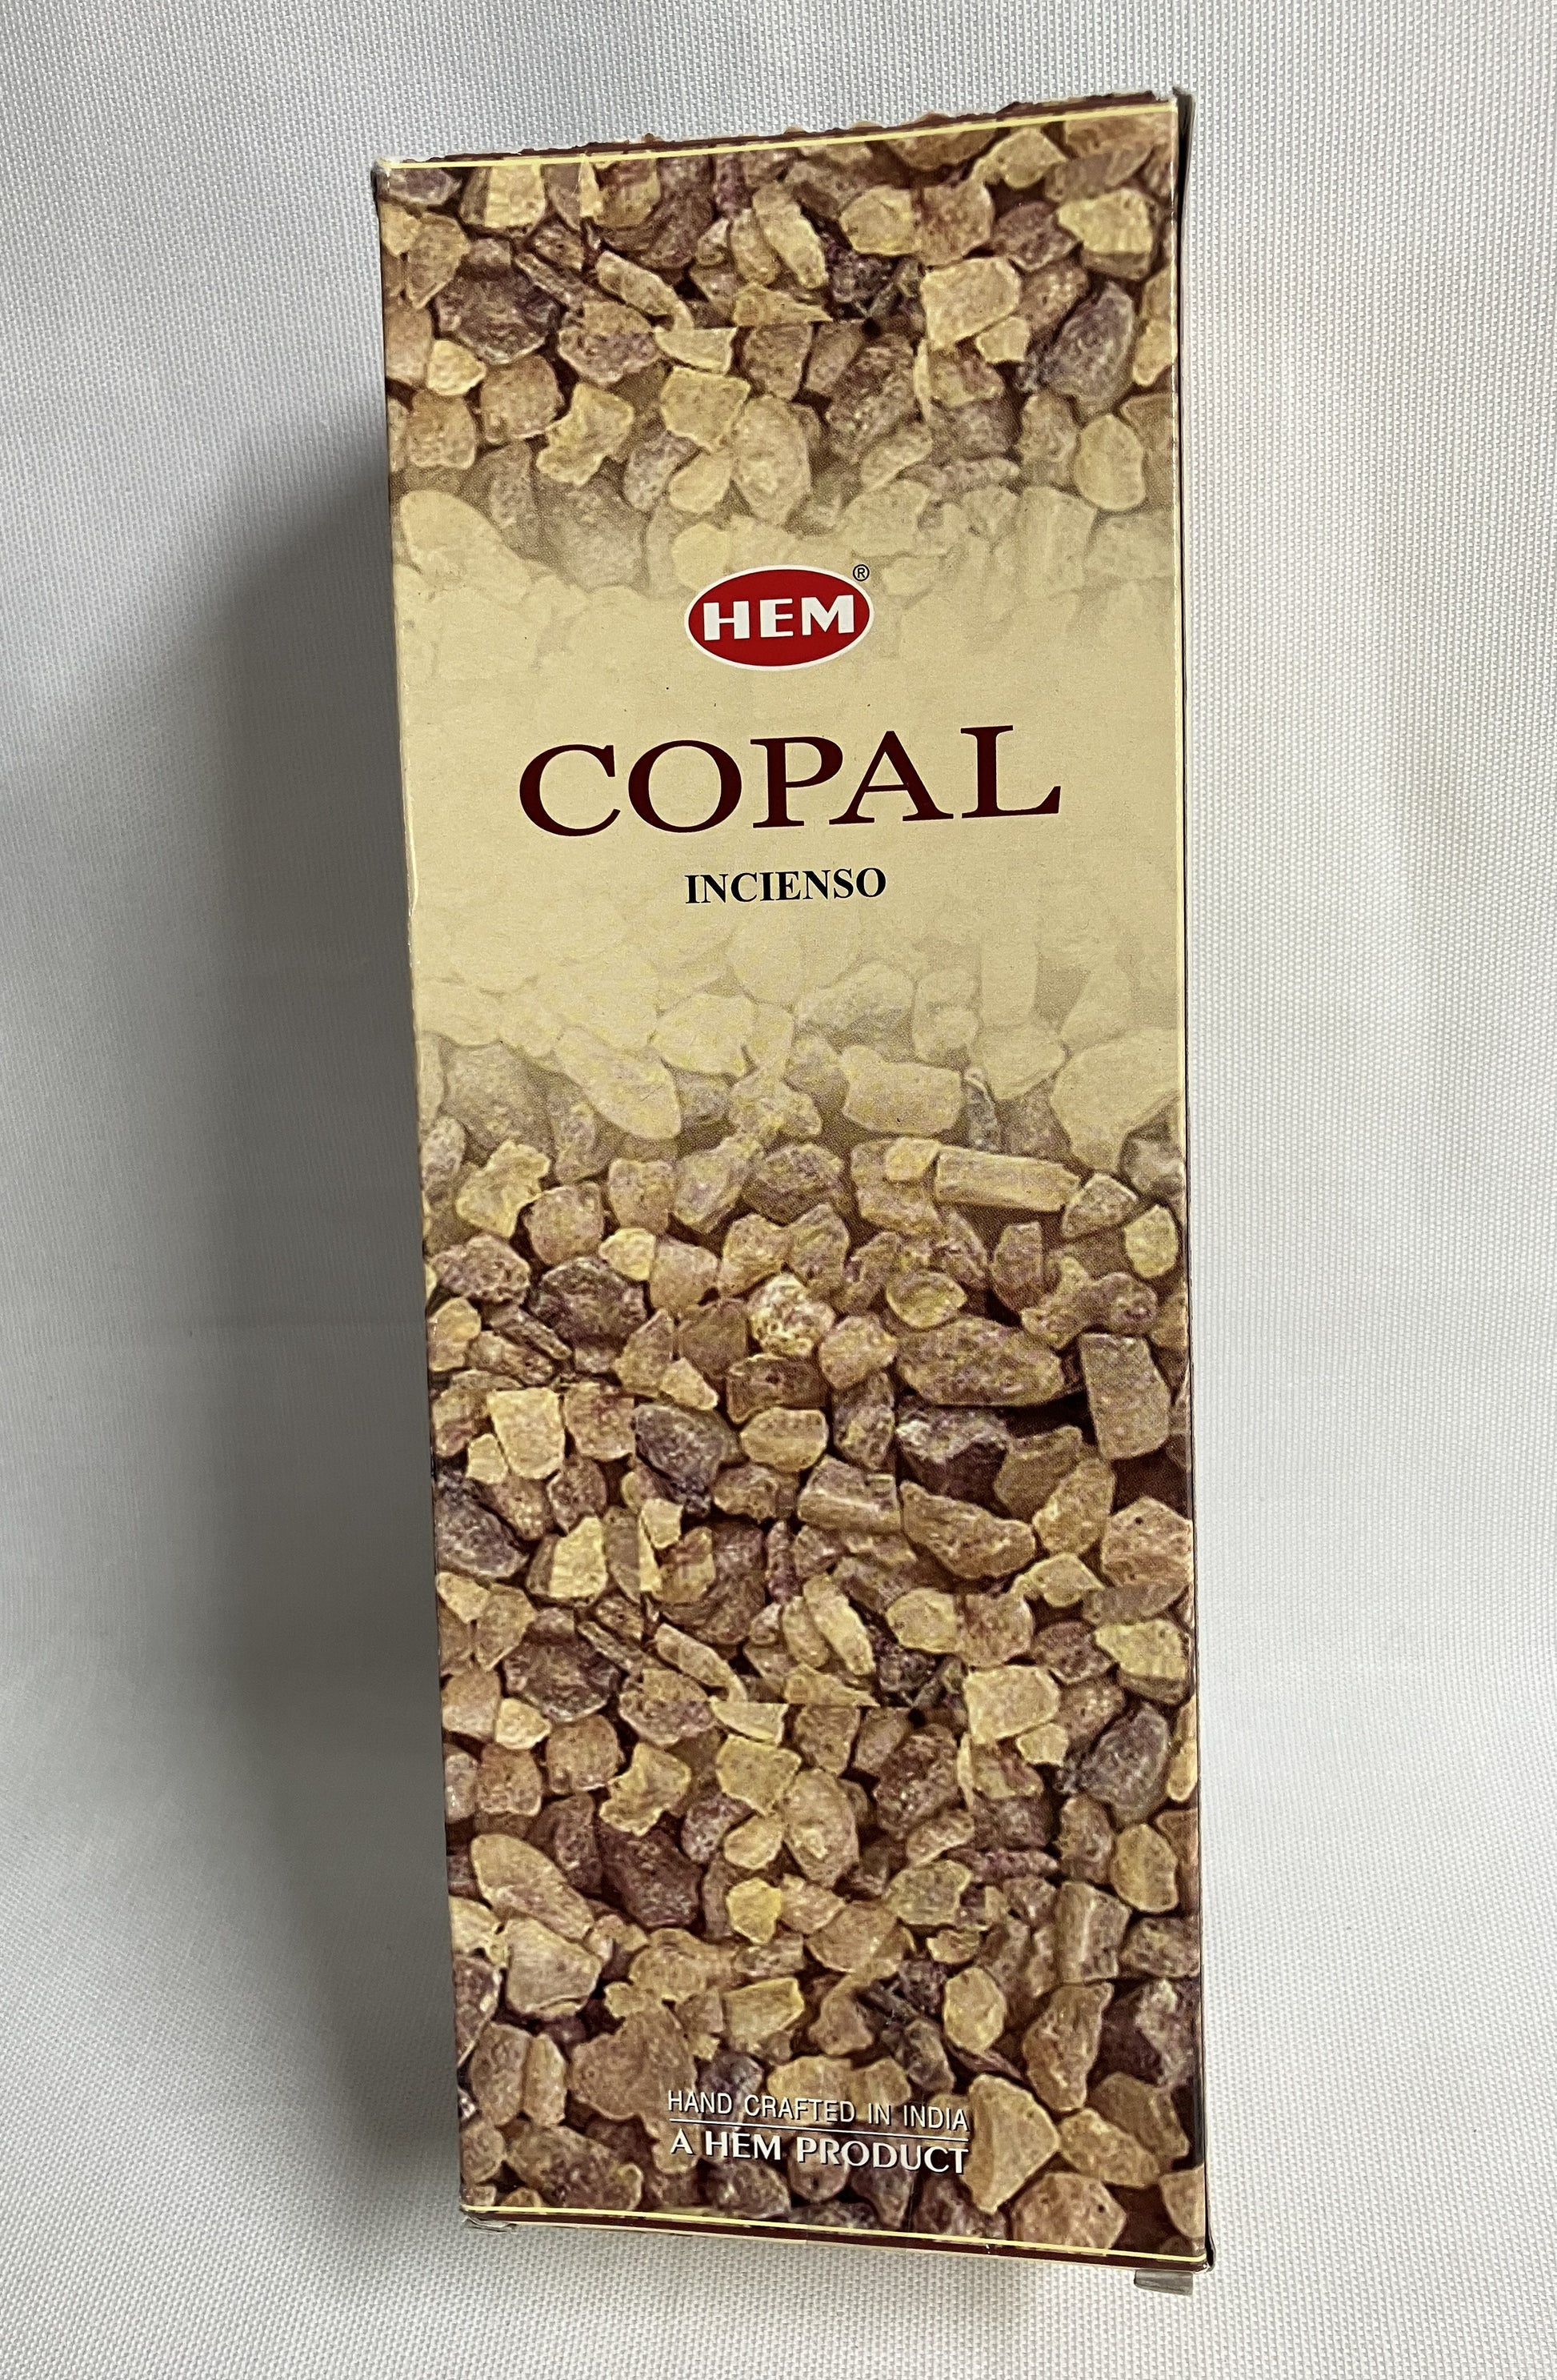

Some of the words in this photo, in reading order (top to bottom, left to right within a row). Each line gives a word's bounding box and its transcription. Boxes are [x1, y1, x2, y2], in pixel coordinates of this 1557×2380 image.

[702, 594, 855, 641] HEM
[518, 724, 1062, 837] COPAL
[684, 867, 887, 904] INCIENSO
[667, 2090, 733, 2114] HAND
[743, 2094, 855, 2123] CRAFTED
[867, 2102, 891, 2126] IN
[903, 2105, 969, 2131] INDIA
[670, 2128, 694, 2155] A
[705, 2130, 782, 2161] HEM
[796, 2136, 969, 2174] PRODUCT
